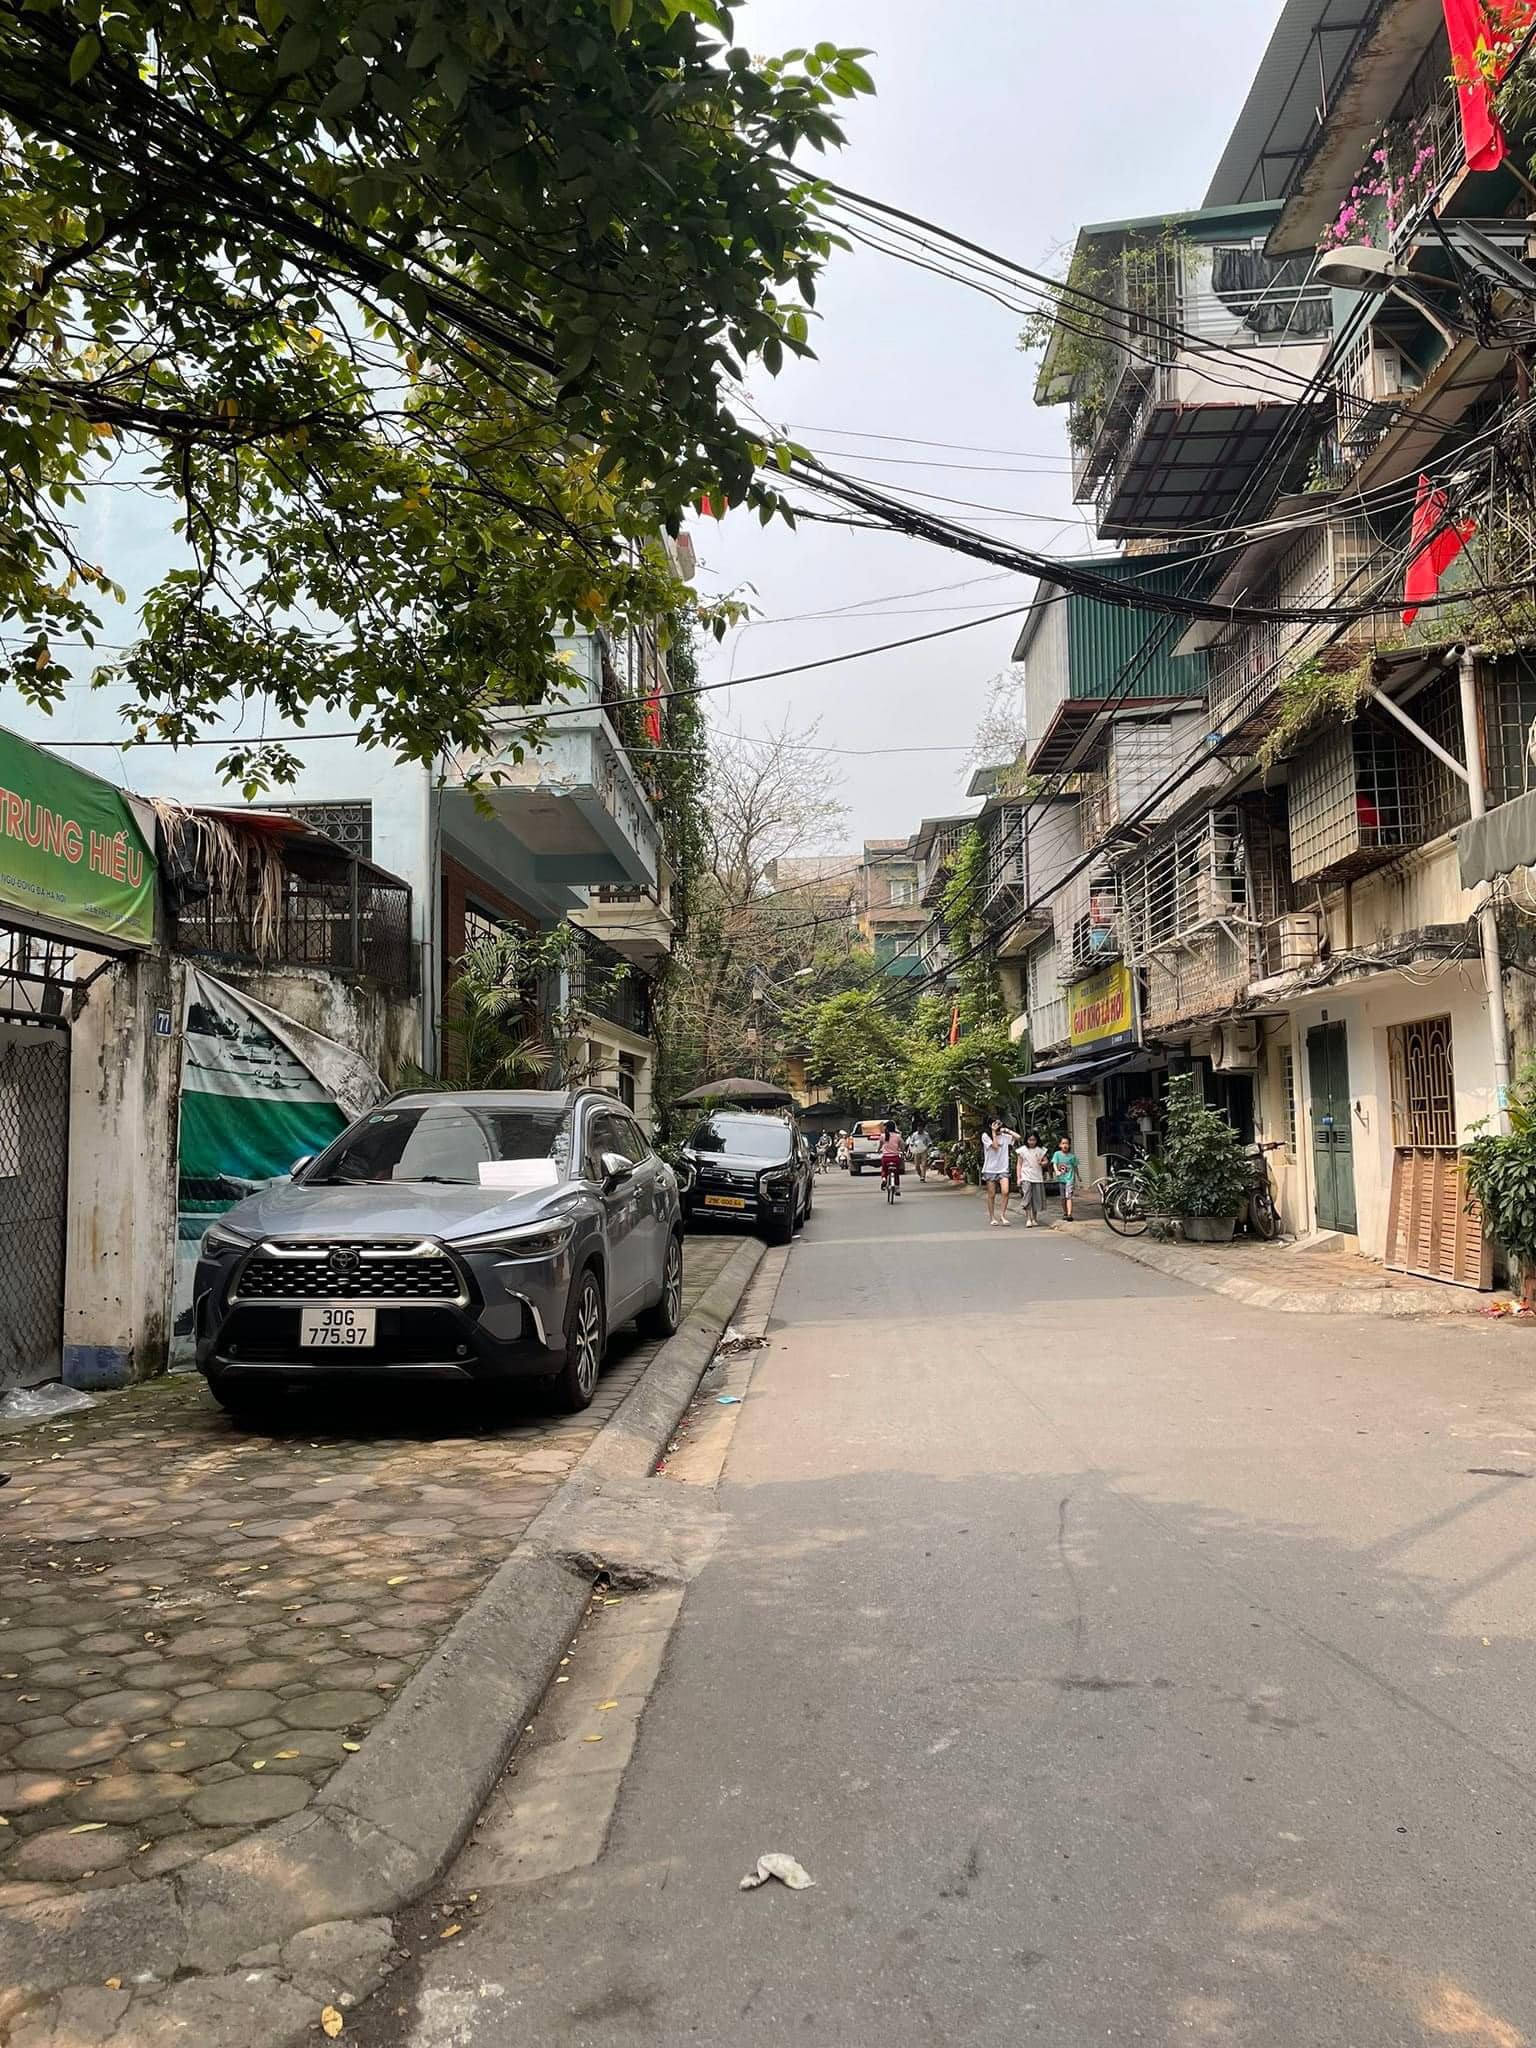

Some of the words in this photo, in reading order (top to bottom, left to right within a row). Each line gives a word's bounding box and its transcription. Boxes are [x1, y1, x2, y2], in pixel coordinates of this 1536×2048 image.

[158, 1013, 169, 1032] 77
[322, 1310, 355, 1326] 30G
[309, 1328, 367, 1345] 775.97
